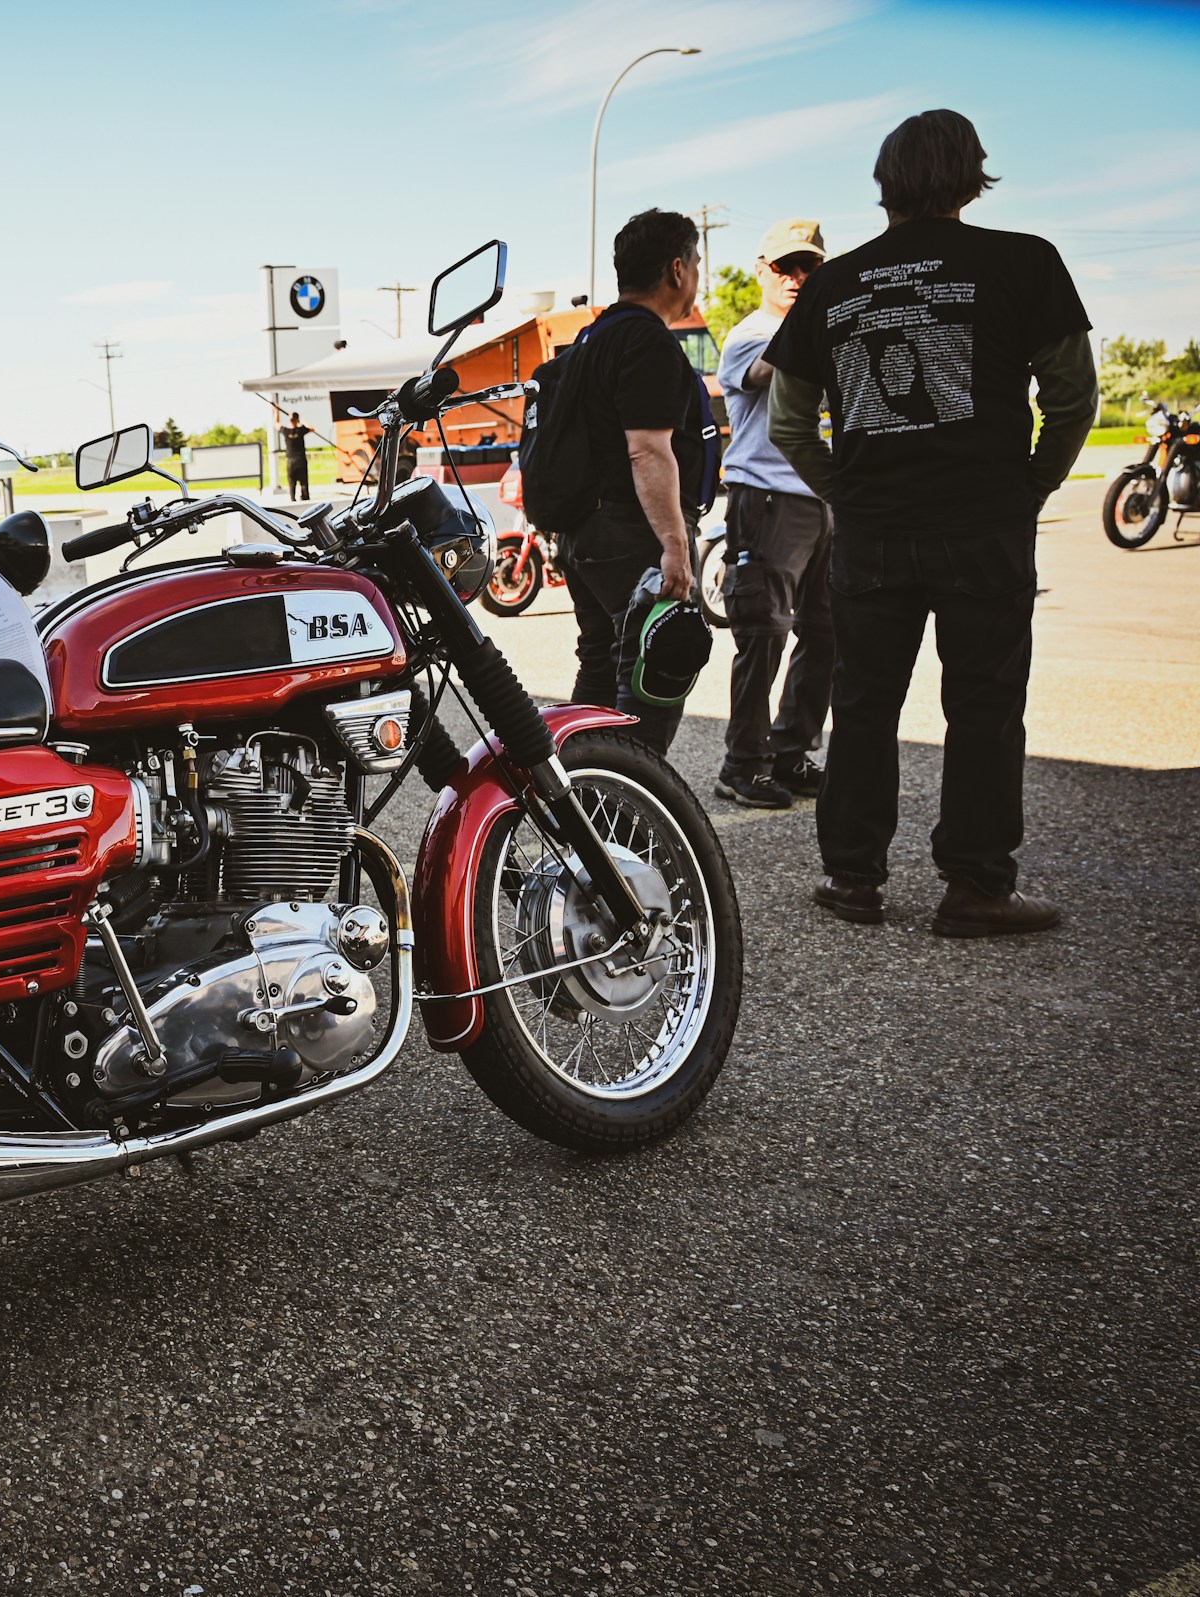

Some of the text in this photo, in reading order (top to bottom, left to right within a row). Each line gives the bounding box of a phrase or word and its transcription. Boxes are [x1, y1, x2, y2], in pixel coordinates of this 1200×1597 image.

[860, 265, 939, 282] MOTORCYCLE RALLY
[874, 264, 900, 274] Annual
[873, 280, 913, 290] Sponsored
[306, 612, 369, 641] BSA
[645, 607, 679, 650] FACTORY RACING
[45, 795, 68, 818] 3
